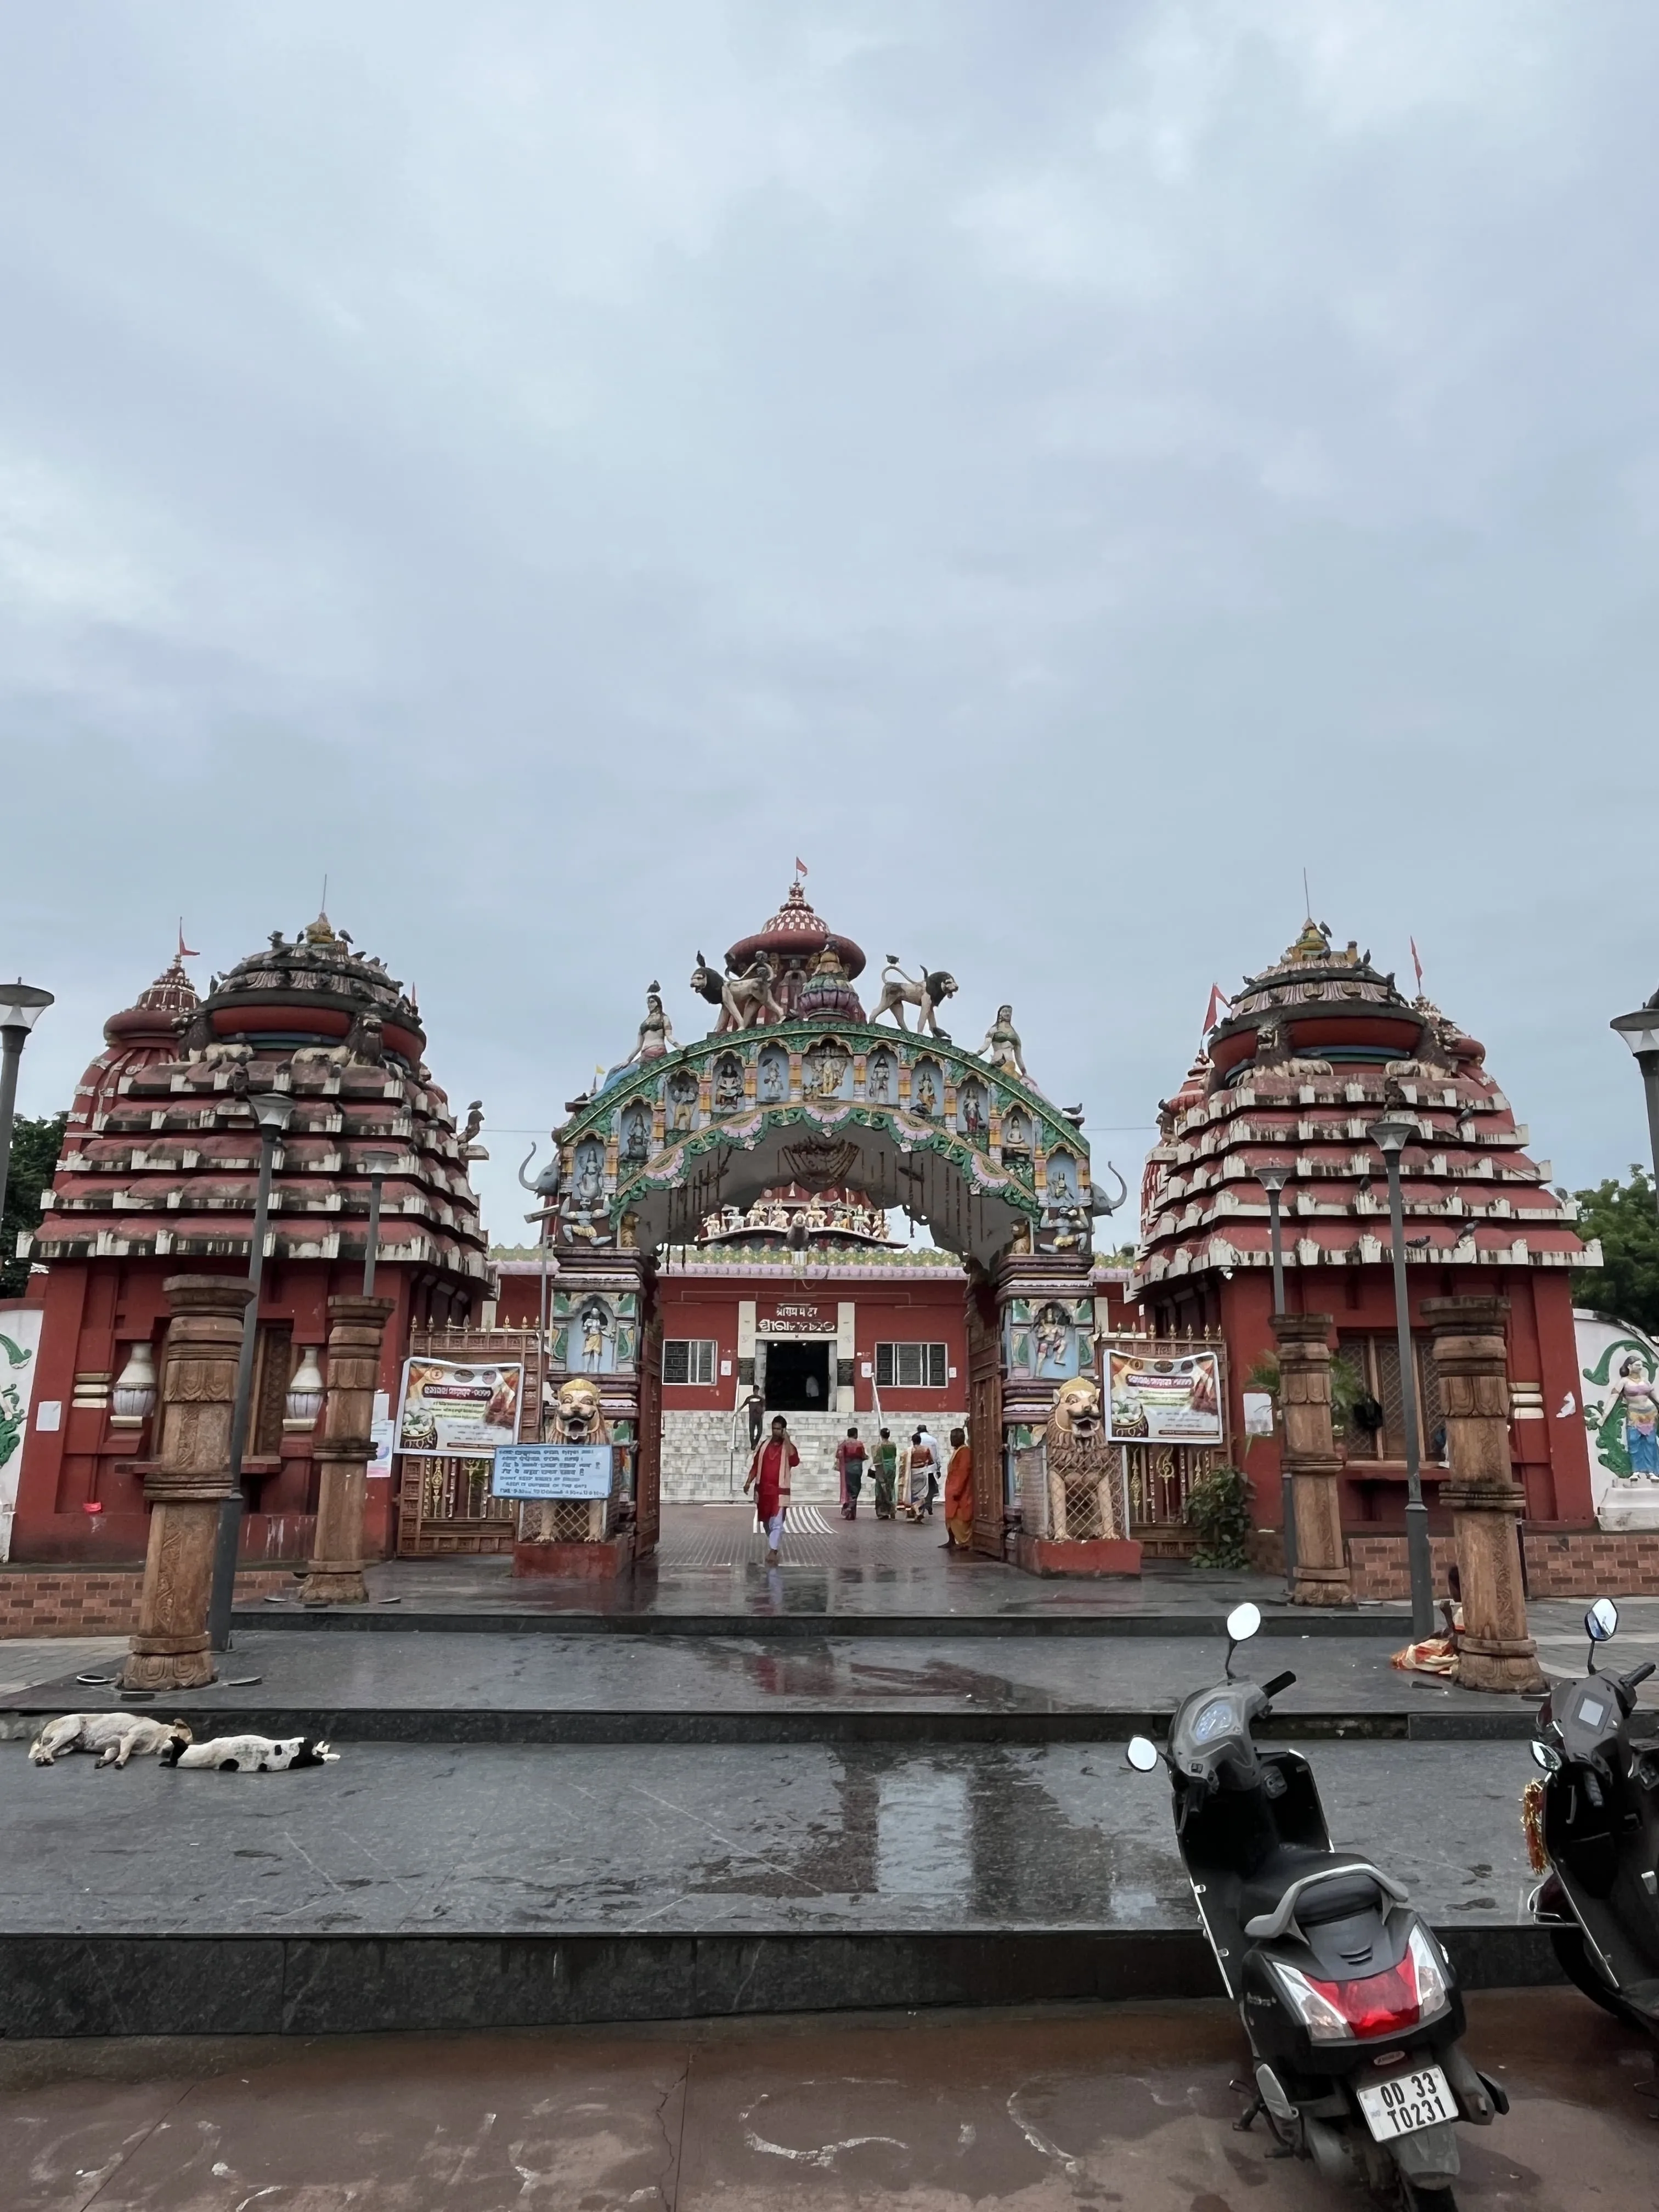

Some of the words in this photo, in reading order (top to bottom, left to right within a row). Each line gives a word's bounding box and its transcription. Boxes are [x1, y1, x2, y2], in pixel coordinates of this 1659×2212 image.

[1380, 2082, 1405, 2108] OD
[1411, 2072, 1437, 2098] 33
[1387, 2096, 1447, 2132] T0231
